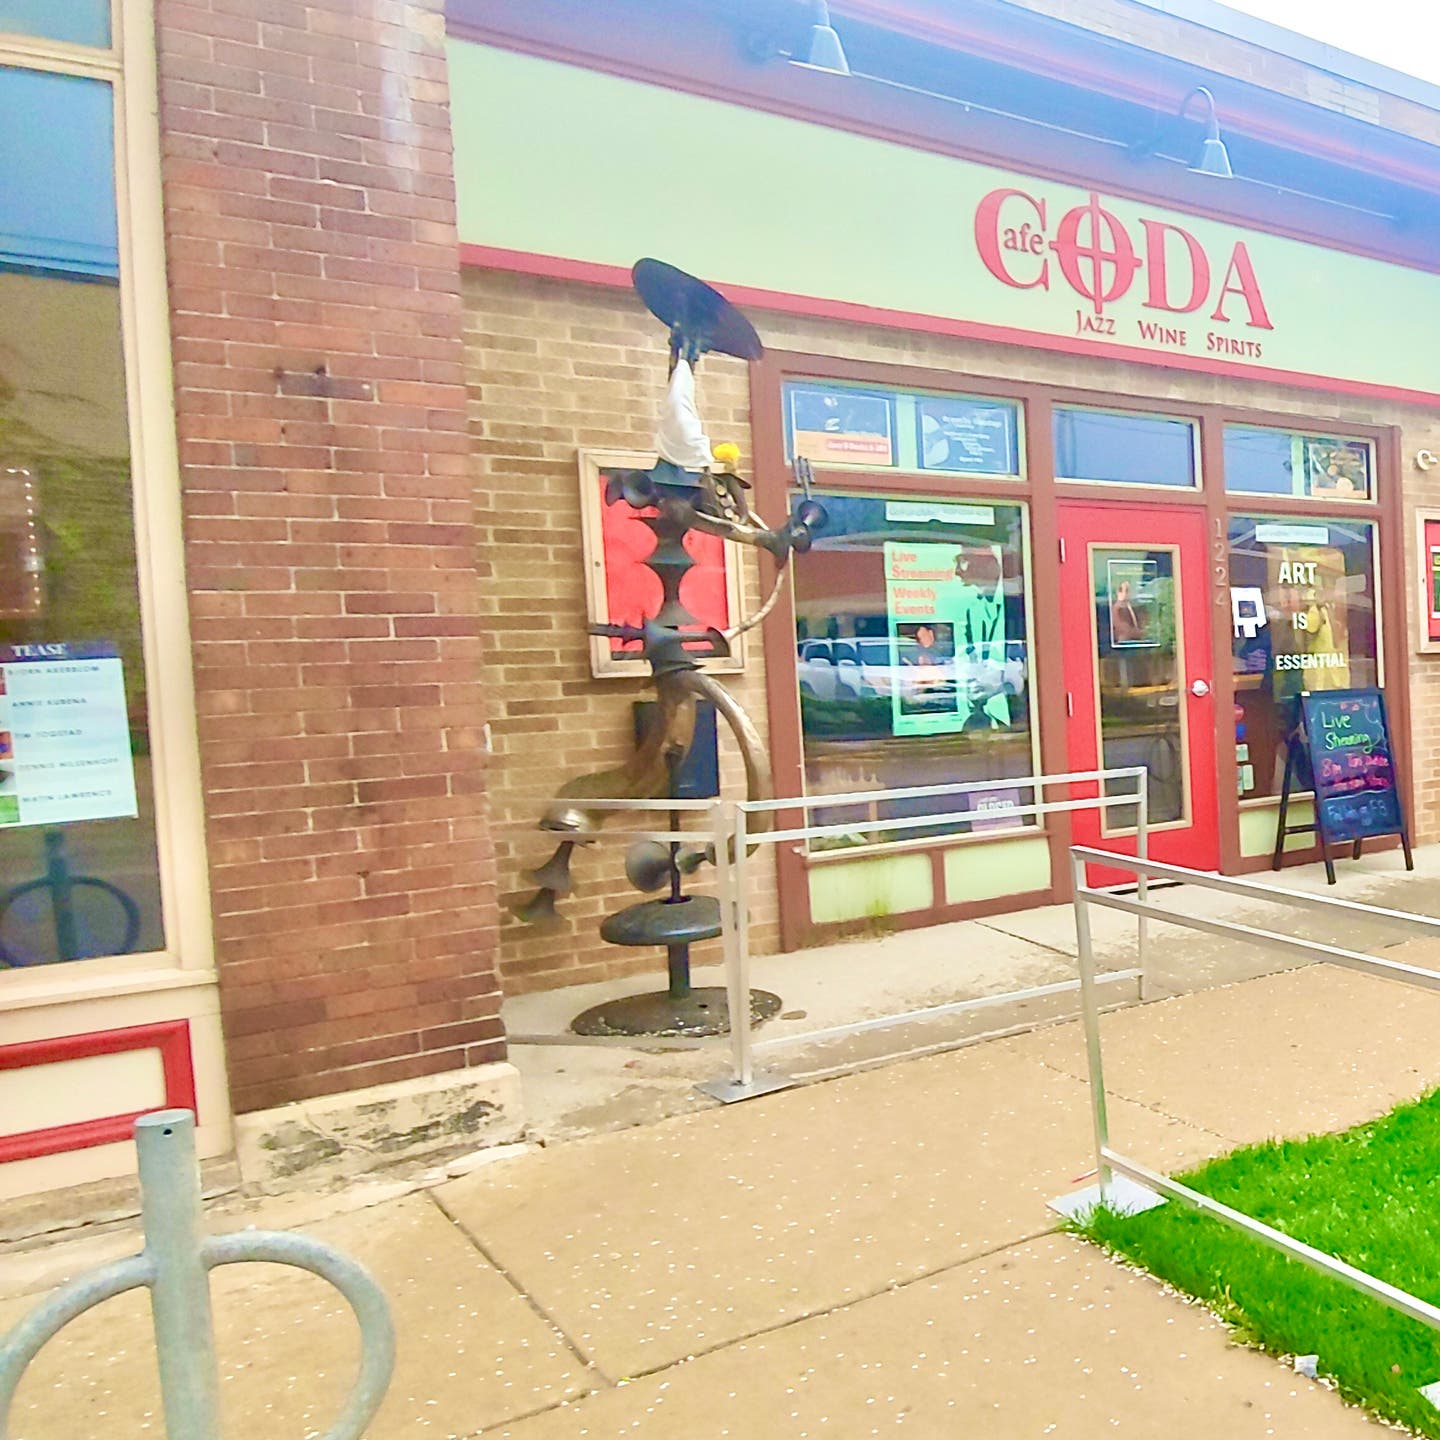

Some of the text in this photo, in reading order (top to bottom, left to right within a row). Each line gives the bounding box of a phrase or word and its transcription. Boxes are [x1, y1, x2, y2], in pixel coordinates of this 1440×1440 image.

[891, 551, 917, 563] Live
[1277, 562, 1318, 585] ART
[893, 587, 937, 602] Weekly
[894, 604, 936, 616] Events
[1292, 612, 1309, 630] IS
[11, 643, 67, 657] TEASE
[1275, 652, 1348, 671] ESSENTIAL
[1320, 711, 1351, 728] Live
